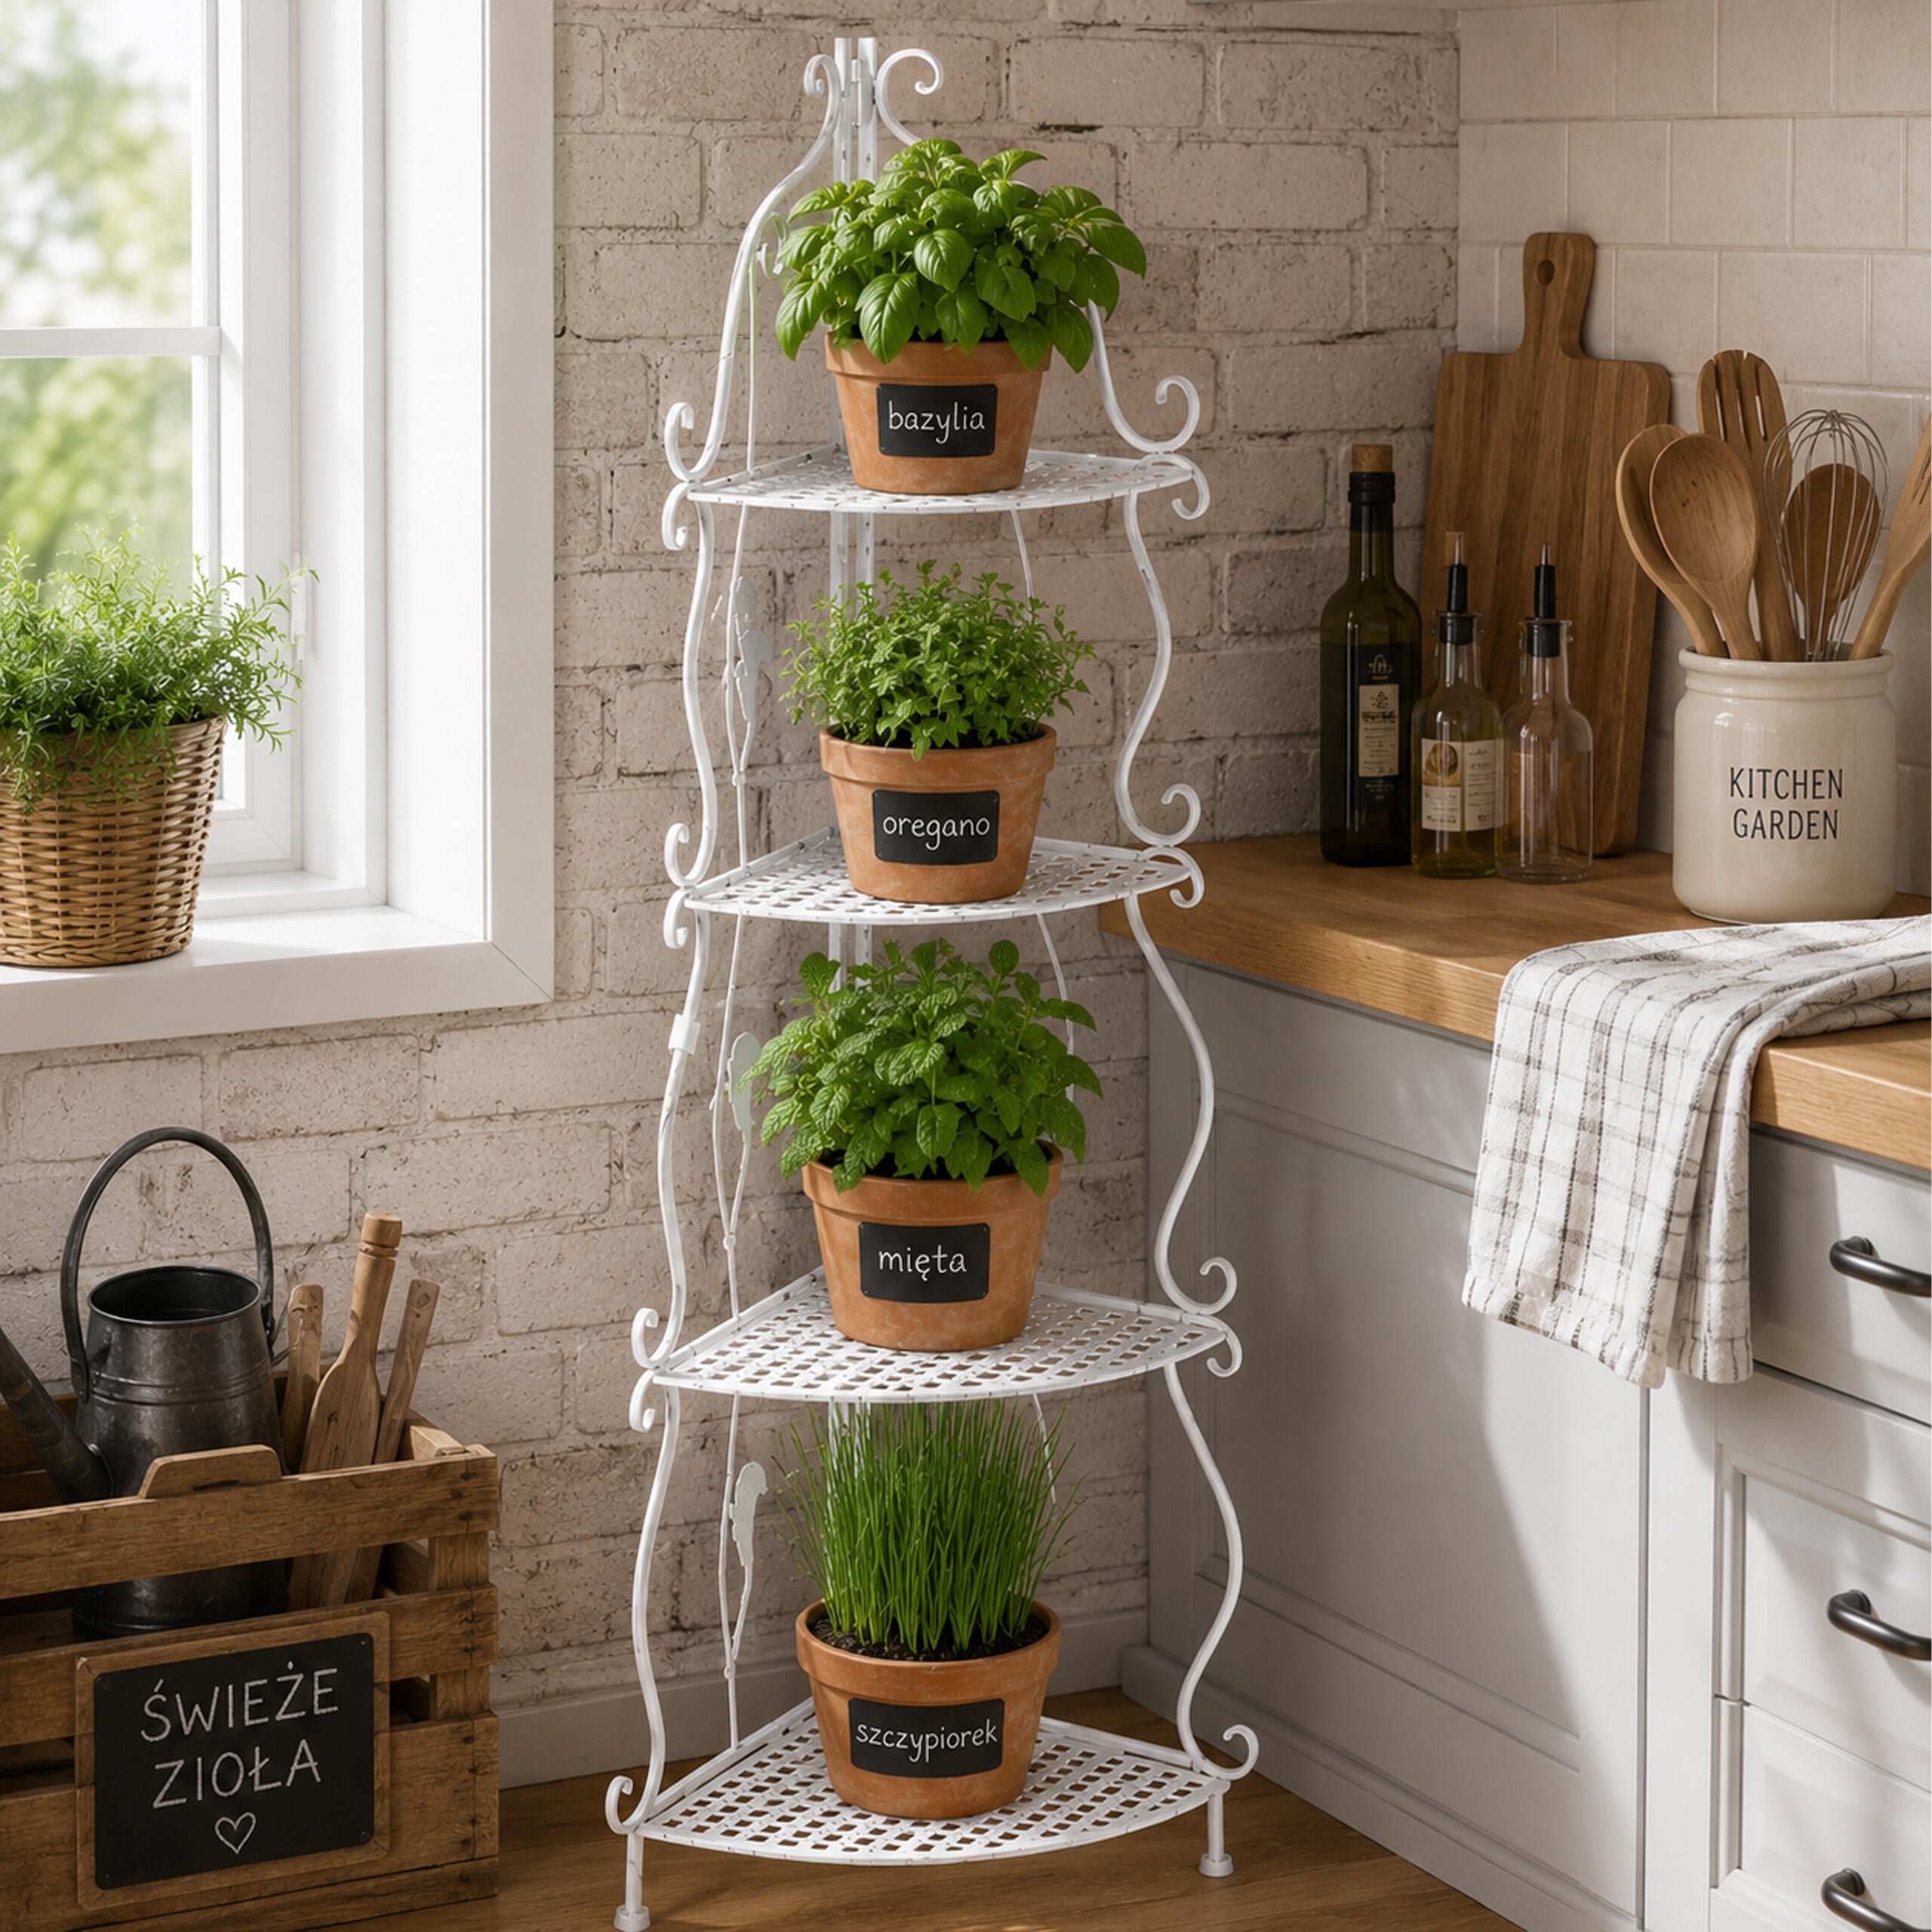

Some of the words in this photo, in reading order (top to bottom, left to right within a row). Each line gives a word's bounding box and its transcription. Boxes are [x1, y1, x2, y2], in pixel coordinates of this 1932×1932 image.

[888, 400, 985, 445] bazylia
[1730, 767, 1844, 800] KITCHEN
[882, 816, 990, 851] oregano
[1733, 808, 1839, 841] GARDEN
[878, 1244, 968, 1281] mięta
[140, 1660, 339, 1743] ŚWIEŻE
[855, 1718, 998, 1763] szczypiorek
[152, 1738, 321, 1809] ZIOŁA
